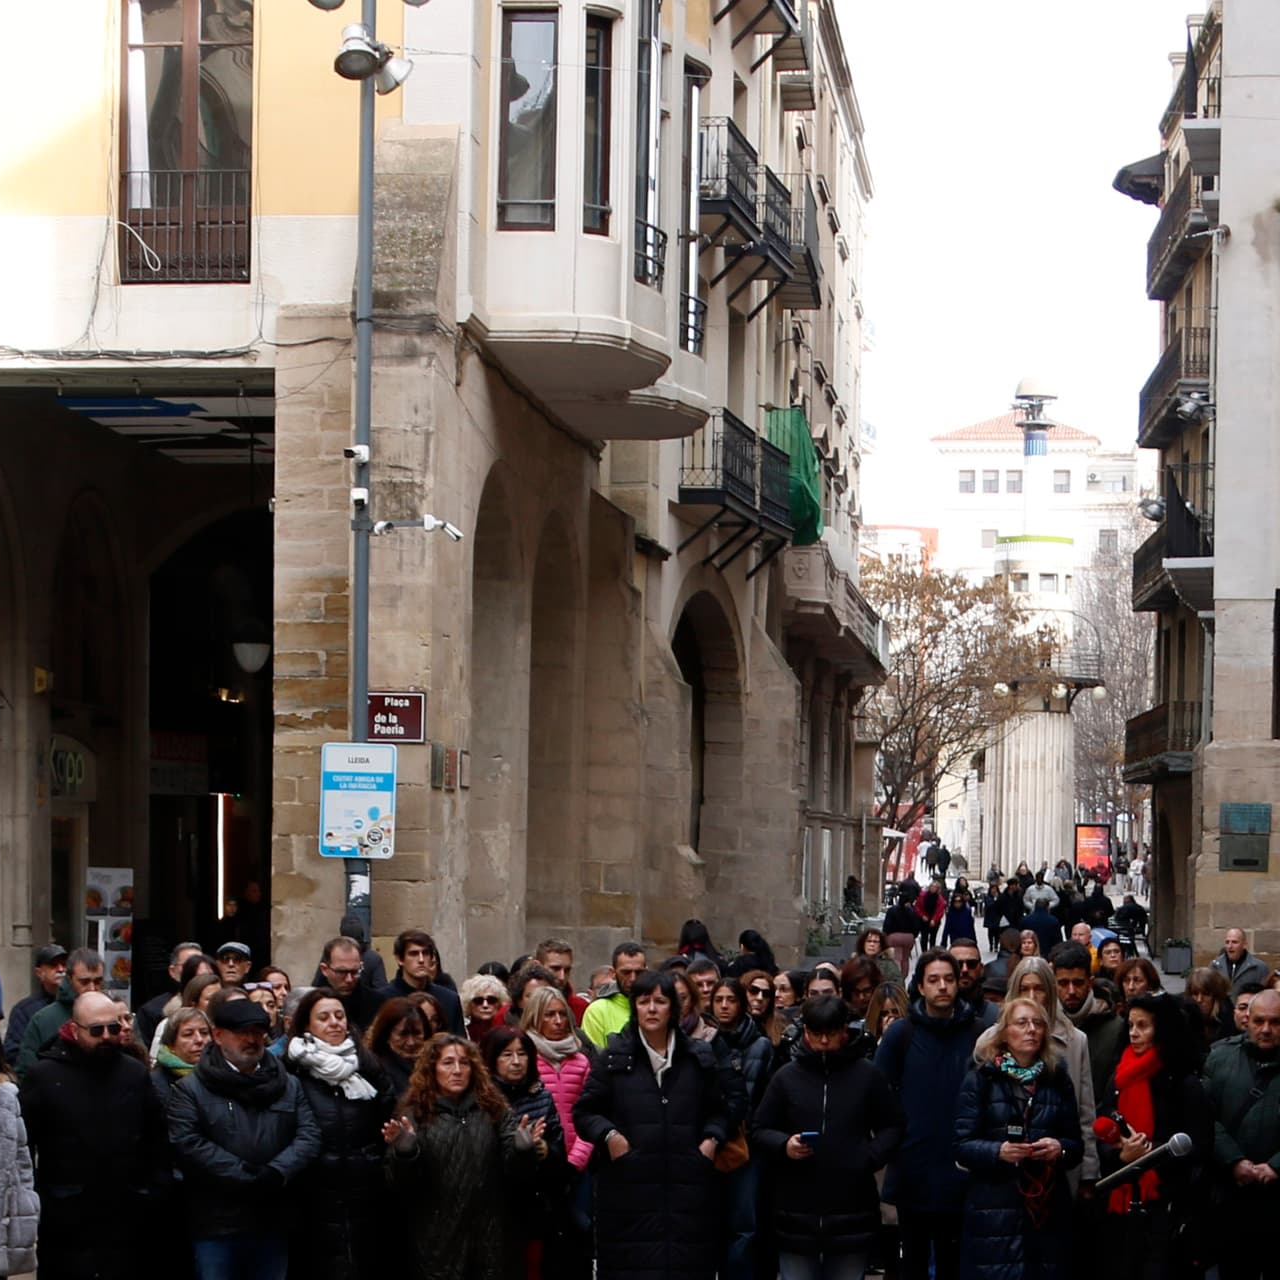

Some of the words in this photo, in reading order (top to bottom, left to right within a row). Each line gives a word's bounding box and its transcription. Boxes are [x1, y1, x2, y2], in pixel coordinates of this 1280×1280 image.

[384, 697, 410, 708] Plaça
[374, 712, 387, 724] de
[388, 712, 398, 724] la
[374, 724, 405, 735] Paeria
